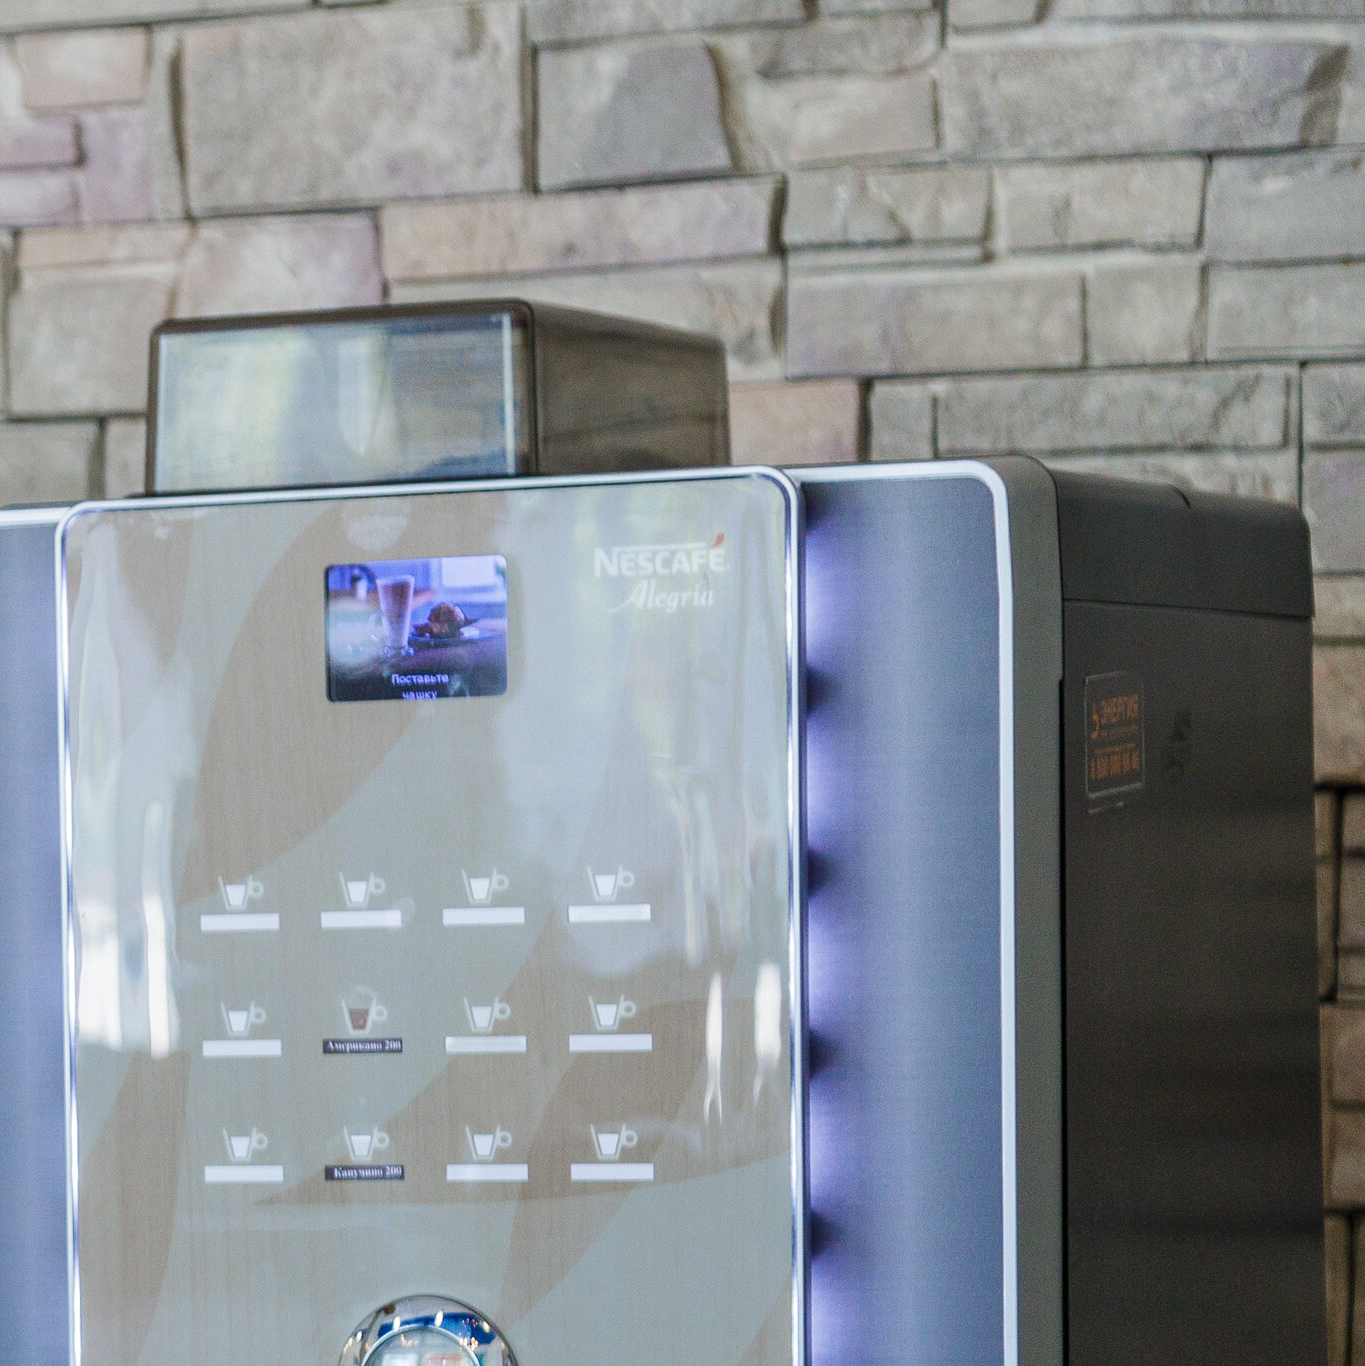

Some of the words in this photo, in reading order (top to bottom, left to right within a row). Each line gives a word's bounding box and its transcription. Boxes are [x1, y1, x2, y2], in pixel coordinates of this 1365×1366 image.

[594, 533, 726, 577] NESCAFÉ
[608, 579, 715, 615] Alegria
[391, 673, 450, 686] Поставьте
[402, 691, 438, 700] чашку
[327, 1040, 383, 1053] Американо
[334, 1167, 383, 1180] Капучино
